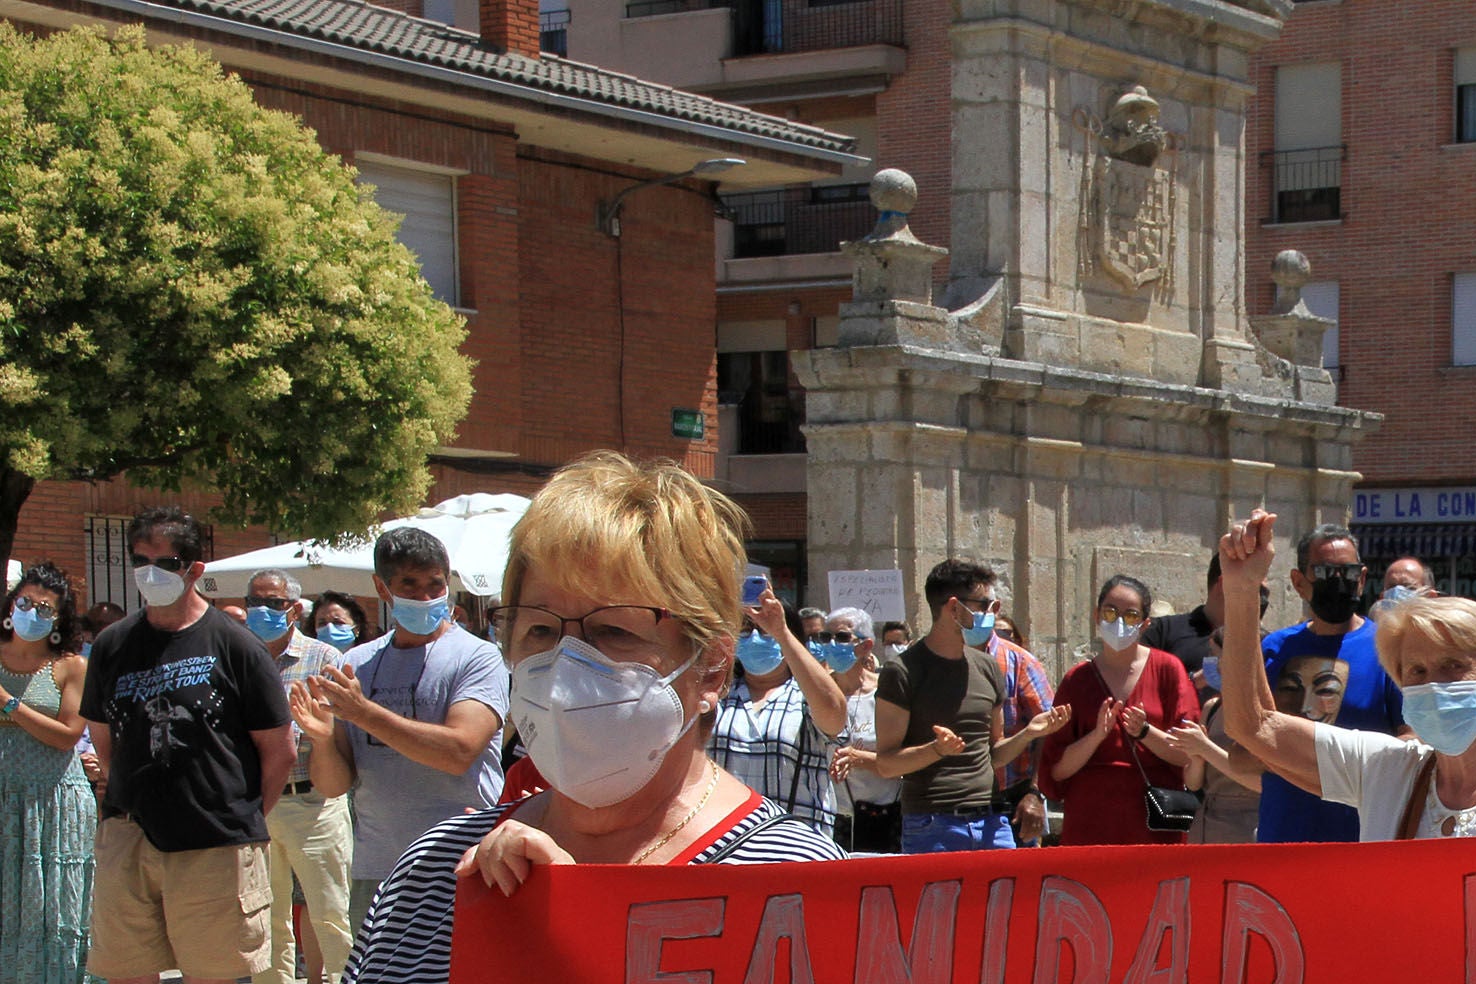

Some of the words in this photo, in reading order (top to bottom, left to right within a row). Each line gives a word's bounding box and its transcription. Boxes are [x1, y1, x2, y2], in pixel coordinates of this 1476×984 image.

[1356, 494, 1381, 518] DE
[1395, 493, 1422, 518] LA
[862, 599, 883, 614] YA
[178, 663, 213, 677] BAND
[132, 680, 175, 703] RIVER
[175, 672, 211, 689] TOUR
